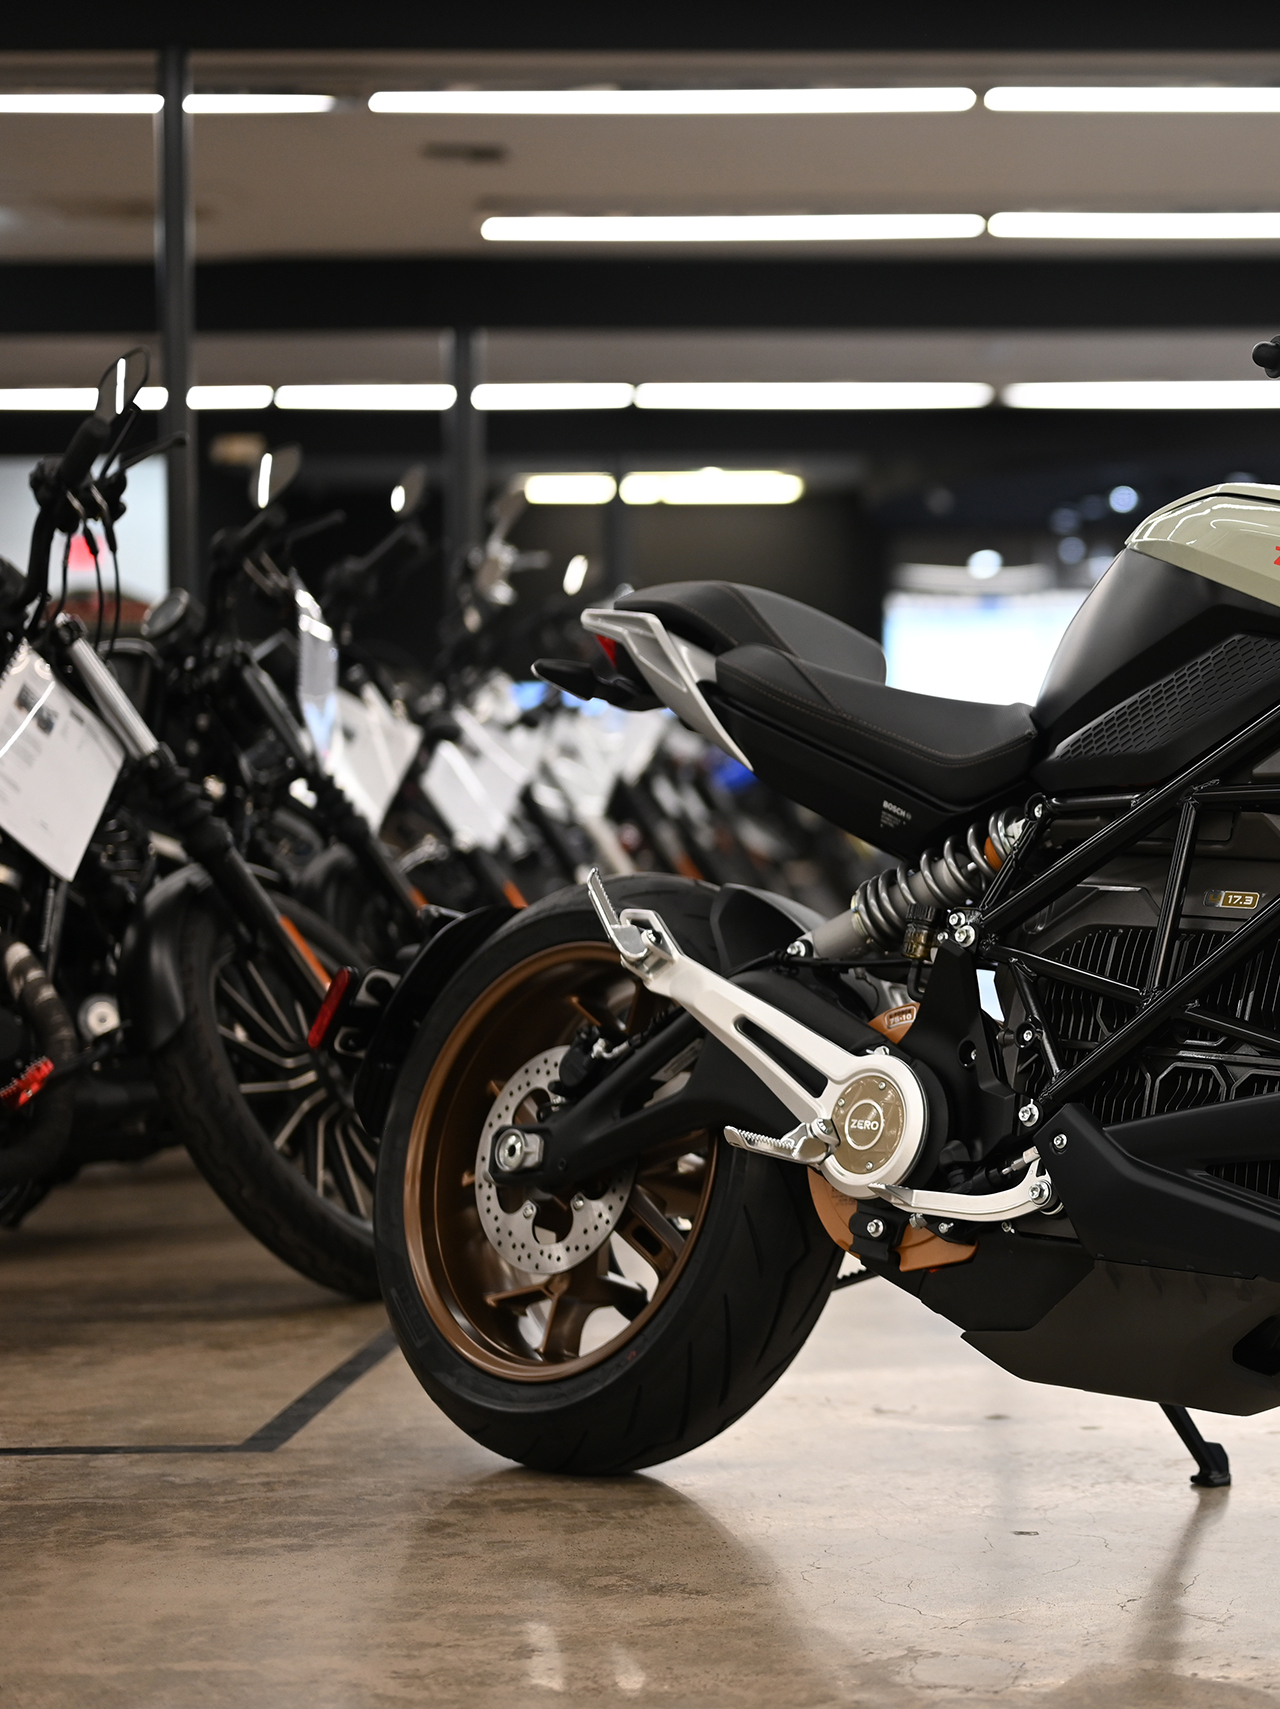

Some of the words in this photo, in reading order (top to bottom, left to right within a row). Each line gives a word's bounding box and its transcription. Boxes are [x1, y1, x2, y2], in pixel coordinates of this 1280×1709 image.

[882, 800, 906, 818] BOSCH
[1228, 895, 1254, 905] 17.3
[850, 1119, 880, 1131] ZERO
